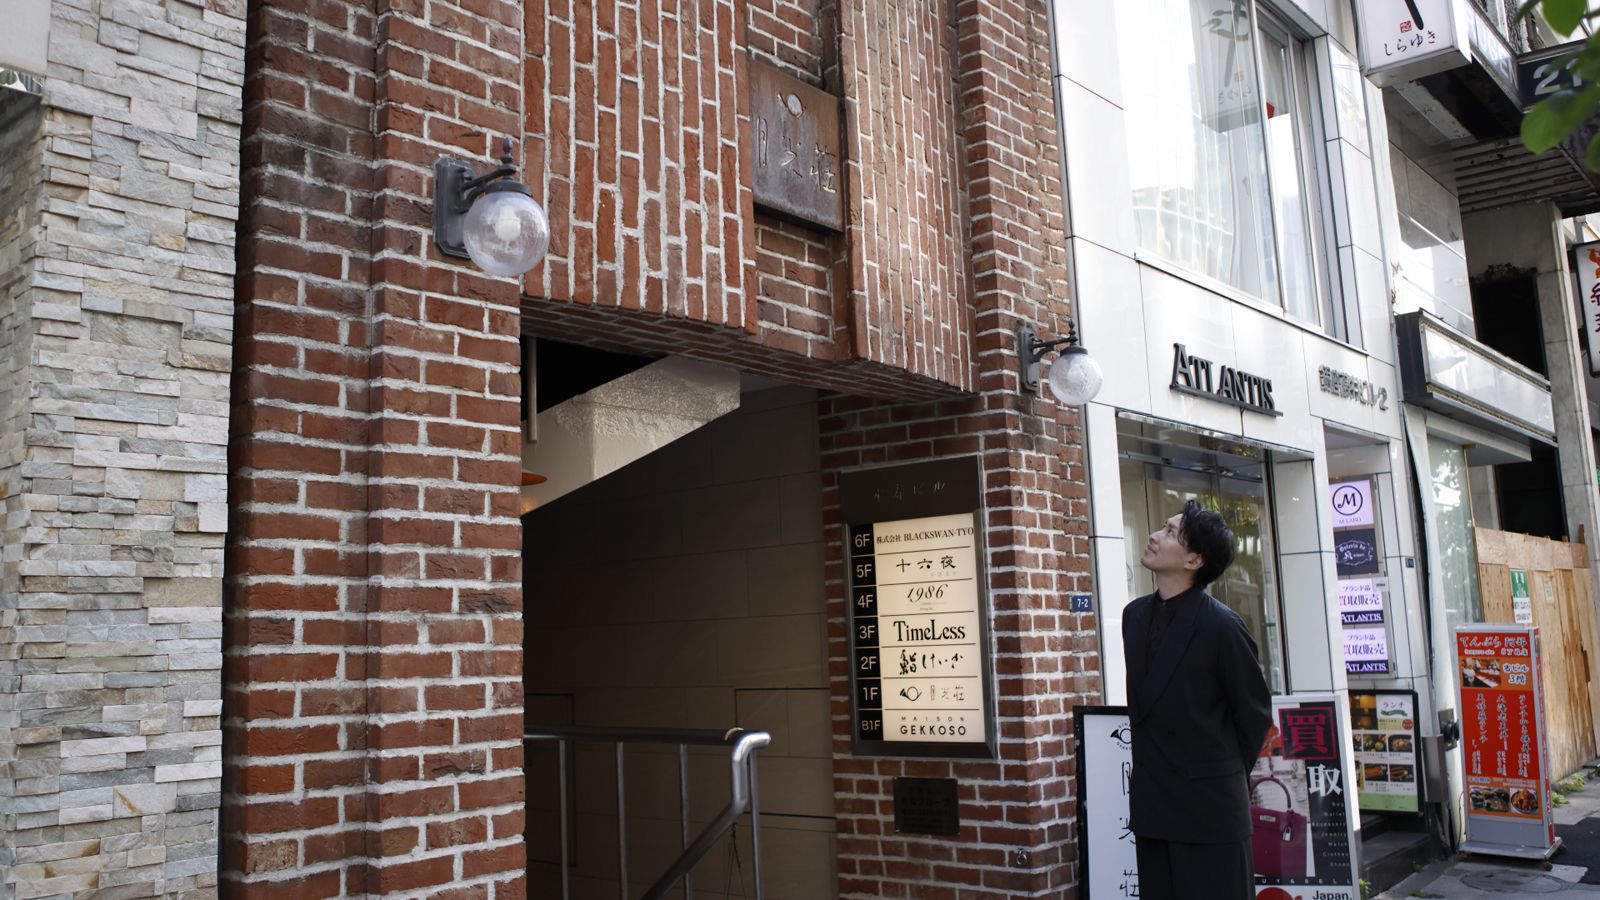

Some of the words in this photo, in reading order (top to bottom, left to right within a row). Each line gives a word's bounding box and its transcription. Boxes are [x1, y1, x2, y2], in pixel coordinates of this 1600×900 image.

[1384, 30, 1436, 56] しらゆき
[854, 533, 871, 548] 6F
[876, 535, 902, 545] 株式会社
[903, 527, 975, 542] BLACKSWAN-TYO
[856, 564, 873, 578] 5F
[896, 555, 957, 573] 十六夜
[907, 583, 949, 603] 1986
[857, 594, 874, 608] 4F
[1077, 598, 1089, 608] 7-2
[1341, 613, 1382, 622] ATLANTIS
[859, 625, 876, 639] 3F
[893, 619, 966, 641] TimeLess
[860, 656, 877, 670] 2F
[1346, 663, 1387, 672] ATLANTIS
[862, 687, 879, 701] 1F
[1382, 701, 1405, 709] ランチ
[861, 719, 881, 731] B1F
[900, 725, 967, 735] GEKKOSO
